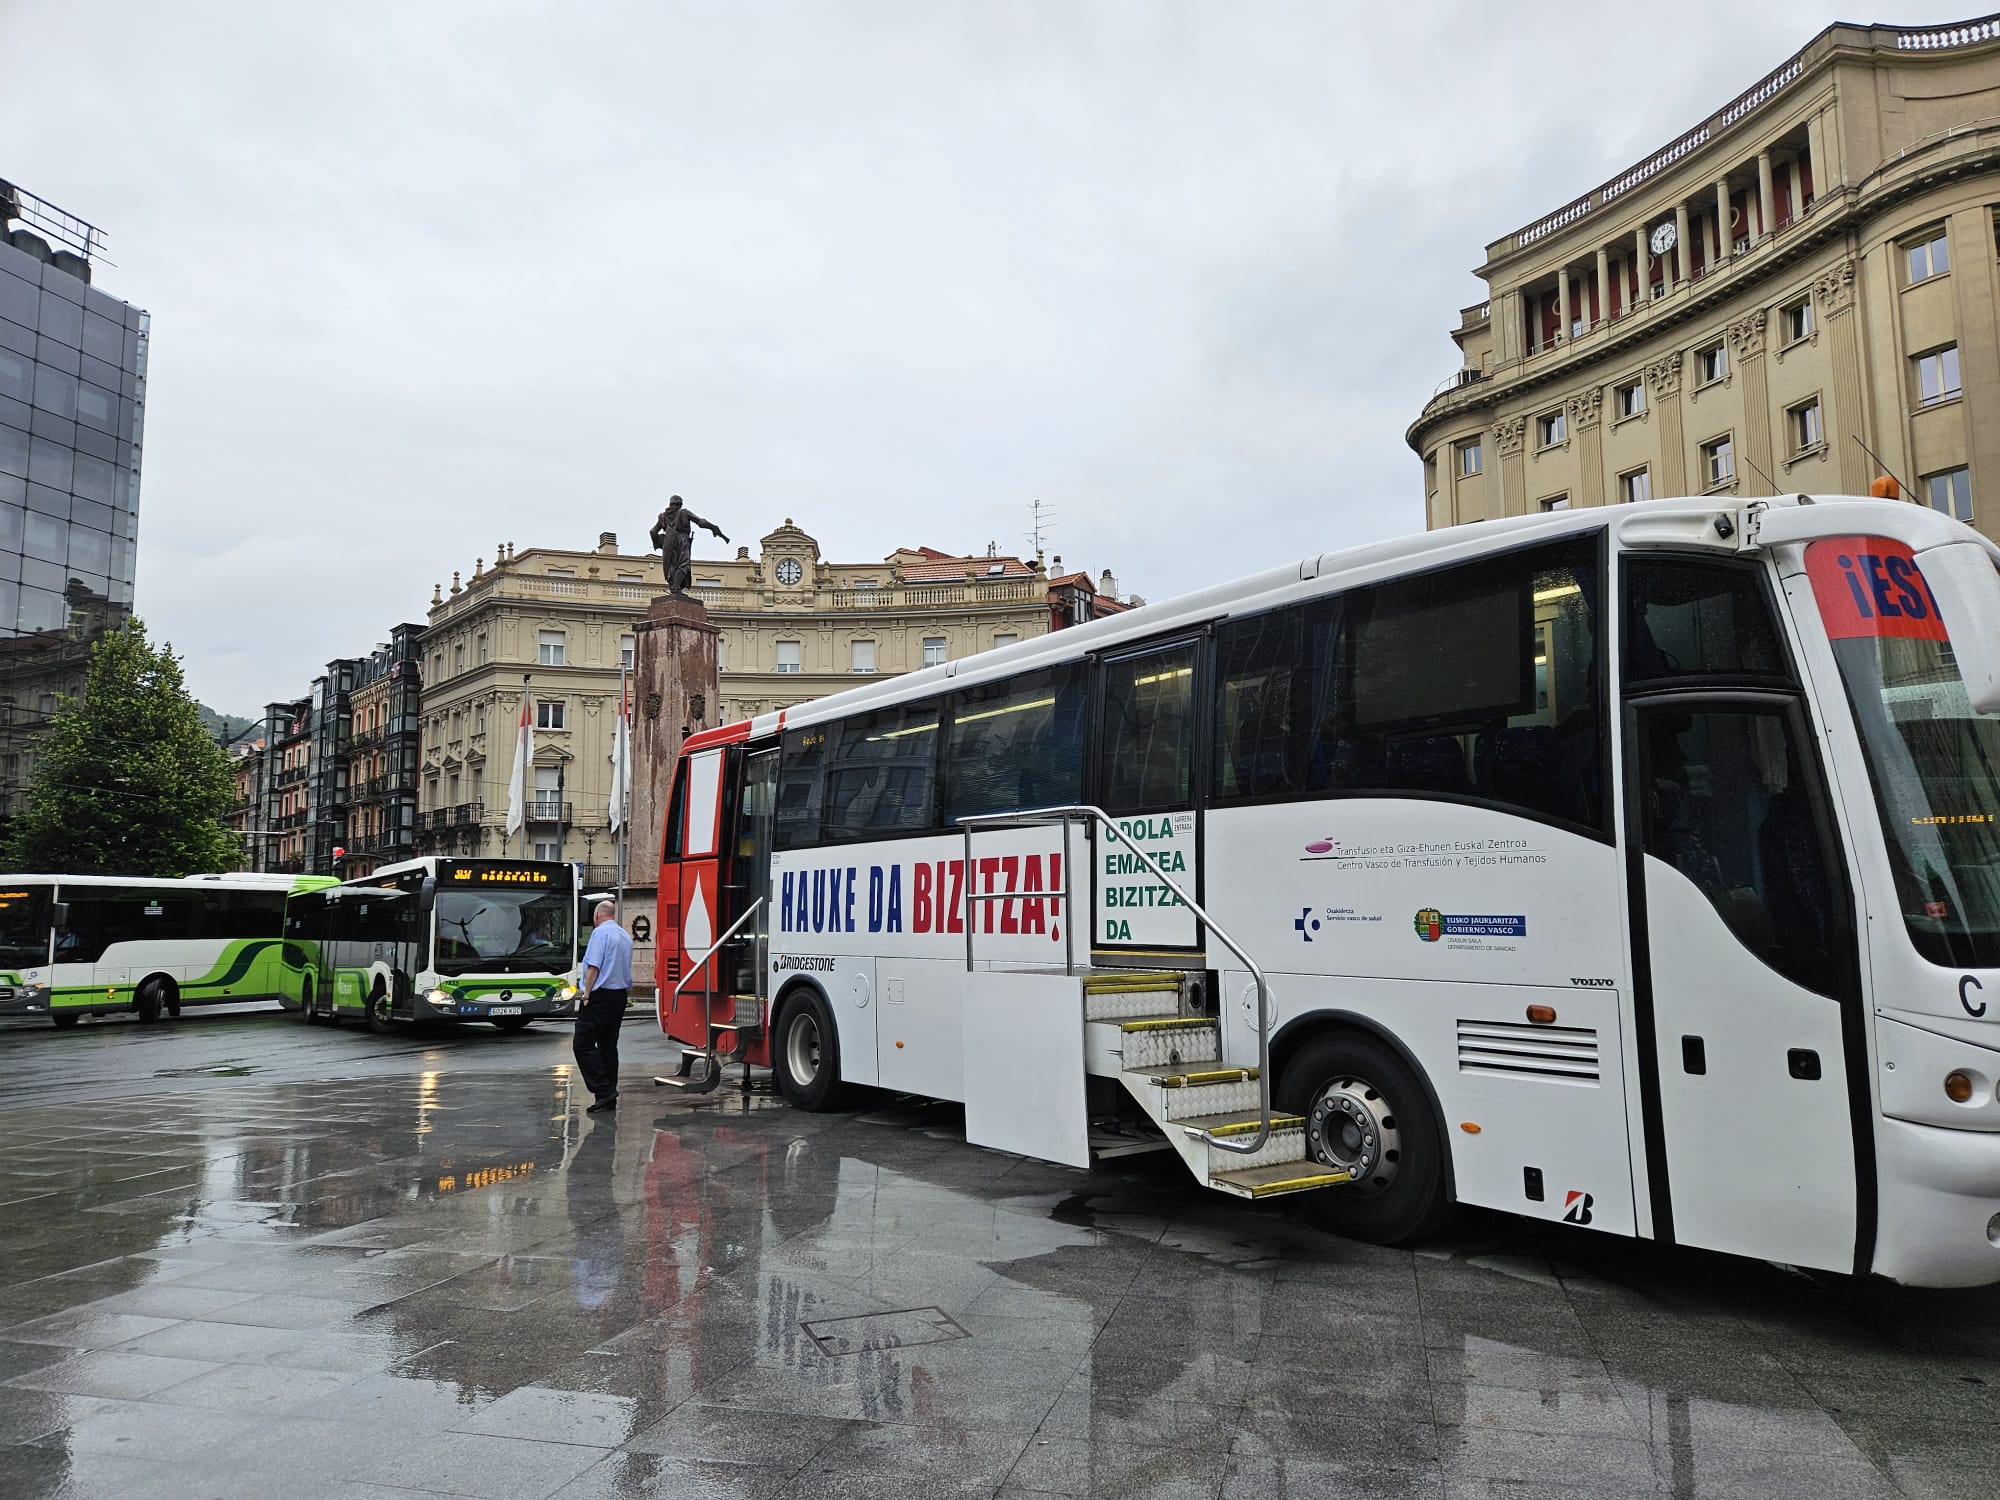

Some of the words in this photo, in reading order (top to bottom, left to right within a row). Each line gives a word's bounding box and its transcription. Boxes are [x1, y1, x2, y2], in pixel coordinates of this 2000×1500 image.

[1105, 817, 1173, 842] ODOLA
[1380, 845, 1394, 854] eta
[1396, 843, 1451, 853] Giza-Ehunen
[1454, 840, 1484, 850] Euskal
[1488, 839, 1527, 849] Zentroa
[1105, 850, 1186, 875] EMATEA
[1337, 861, 1363, 870] Centro
[1365, 860, 1389, 868] Vasco
[1391, 859, 1401, 868] de
[1404, 857, 1452, 867] Transfusión
[1456, 859, 1461, 868] y
[1464, 856, 1497, 867] Tejidos
[1500, 854, 1547, 864] Humanos
[781, 867, 856, 933] HAUXE
[868, 864, 903, 933] DA
[912, 852, 1061, 942] BIZITZA!
[1105, 886, 1186, 908] BIZITZA
[1106, 919, 1132, 941] DA
[1446, 926, 1486, 934] GOBIERNO
[780, 954, 836, 972] BRIDGESTONE
[1570, 977, 1614, 987] VOLVO
